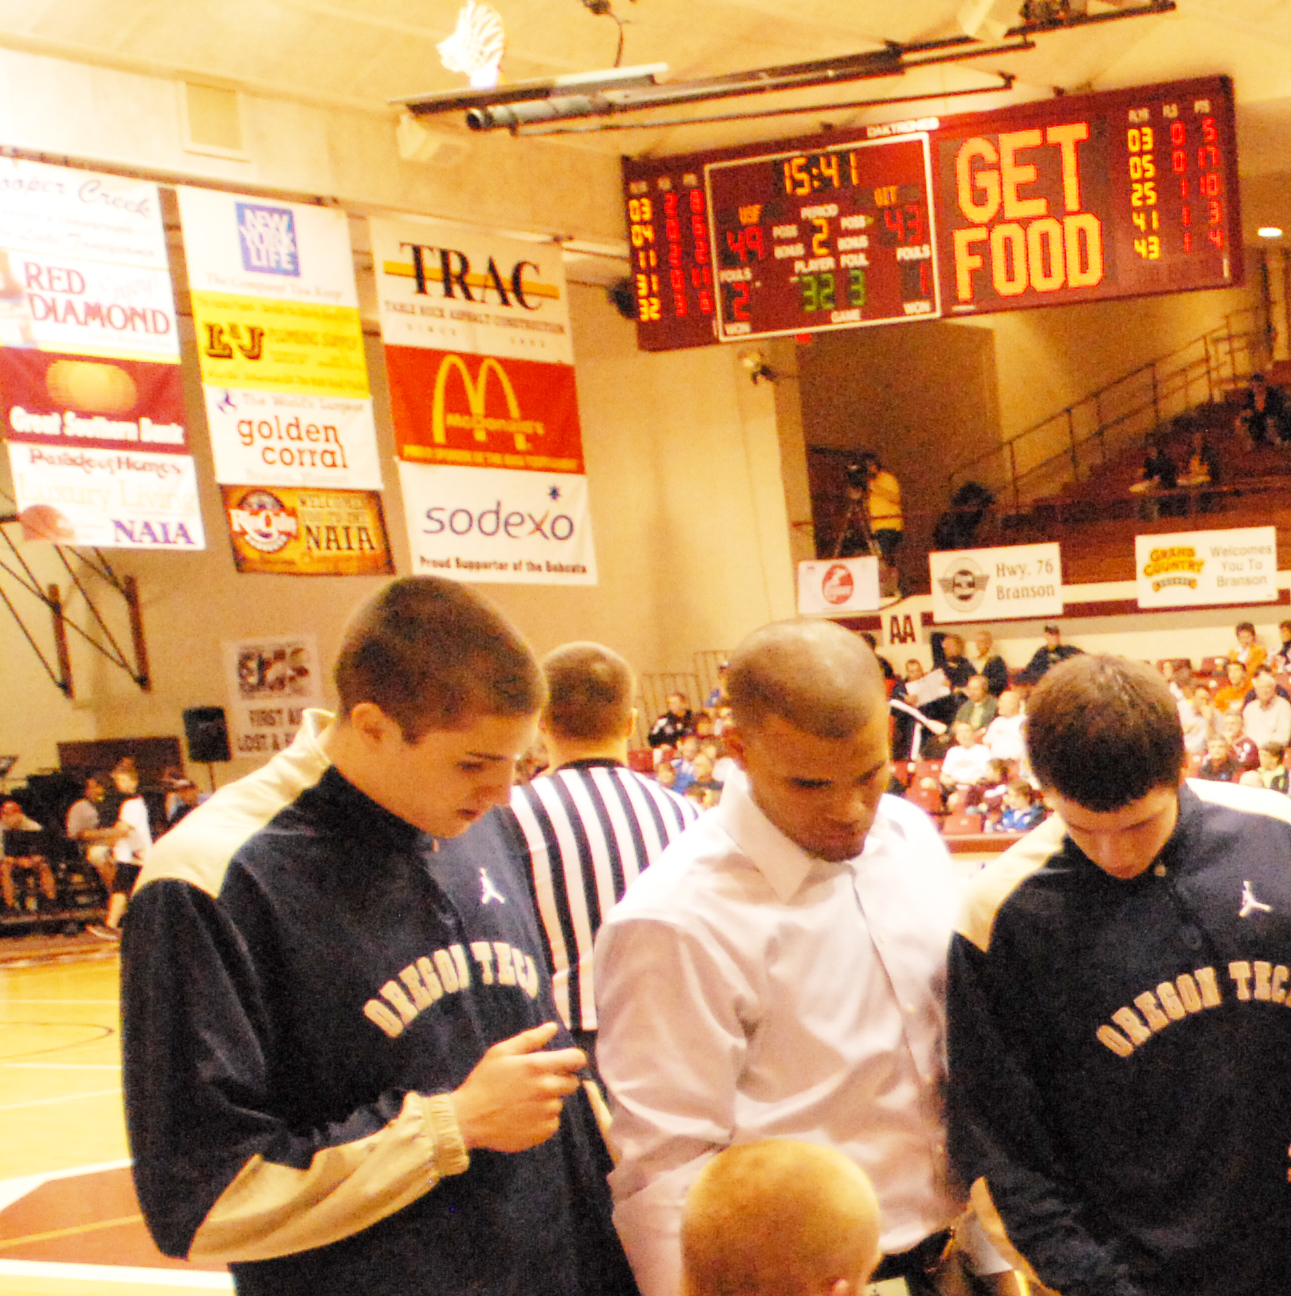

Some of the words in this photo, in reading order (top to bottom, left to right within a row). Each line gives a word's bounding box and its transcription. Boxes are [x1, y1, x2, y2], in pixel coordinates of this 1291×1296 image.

[1127, 126, 1154, 153] 03
[784, 151, 859, 196] 15:41
[956, 121, 1090, 225] GET
[1129, 154, 1156, 180] 05
[78, 178, 152, 219] Creek
[1131, 182, 1158, 207] 25
[244, 208, 289, 233] NEW
[629, 197, 653, 222] 03
[800, 203, 838, 220] PERIOD
[1132, 209, 1159, 232] 41
[812, 218, 830, 256] 2
[884, 204, 923, 243] 43
[239, 225, 296, 253] YORK
[726, 225, 764, 262] 49
[896, 244, 931, 261] FOULS
[1133, 235, 1160, 260] 43
[250, 244, 295, 271] LIFE
[794, 256, 836, 274] PLAYER
[840, 253, 869, 269] FOUL
[952, 212, 1105, 303] FOOD
[23, 260, 86, 296] RED
[399, 241, 544, 311] TRAC
[636, 273, 660, 297] 31
[733, 281, 751, 321] 2
[801, 272, 836, 313] 32
[849, 269, 866, 306] 3
[27, 292, 172, 335] DIAMOND
[638, 297, 662, 322] 32
[903, 301, 931, 315] WON
[10, 405, 62, 436] Great
[63, 411, 139, 442] Southern
[139, 416, 185, 445] Bank
[237, 415, 339, 447] golden
[29, 448, 95, 474] Parade
[116, 456, 183, 479] Homes
[261, 444, 349, 470] corral
[17, 472, 111, 513] Luxury
[119, 479, 197, 517] Living
[112, 519, 195, 546] NAIA
[423, 500, 575, 542] sodexo
[303, 525, 376, 552] NAIA
[1209, 544, 1273, 558] Welcomes
[420, 555, 451, 569] Proud
[456, 557, 509, 573] Supporter
[513, 560, 524, 572] of
[526, 559, 542, 573] the
[1150, 546, 1197, 563] GRAND
[1221, 561, 1244, 573] You
[1247, 558, 1263, 571] To
[995, 561, 1031, 581] Hwy.
[1035, 558, 1055, 576] 76
[1143, 559, 1205, 578] COUNTRY
[1216, 575, 1268, 588] Branson
[995, 582, 1056, 602] Branson
[889, 613, 917, 645] AA
[362, 944, 472, 1040] OREGON
[1096, 965, 1222, 1058] OREGON
